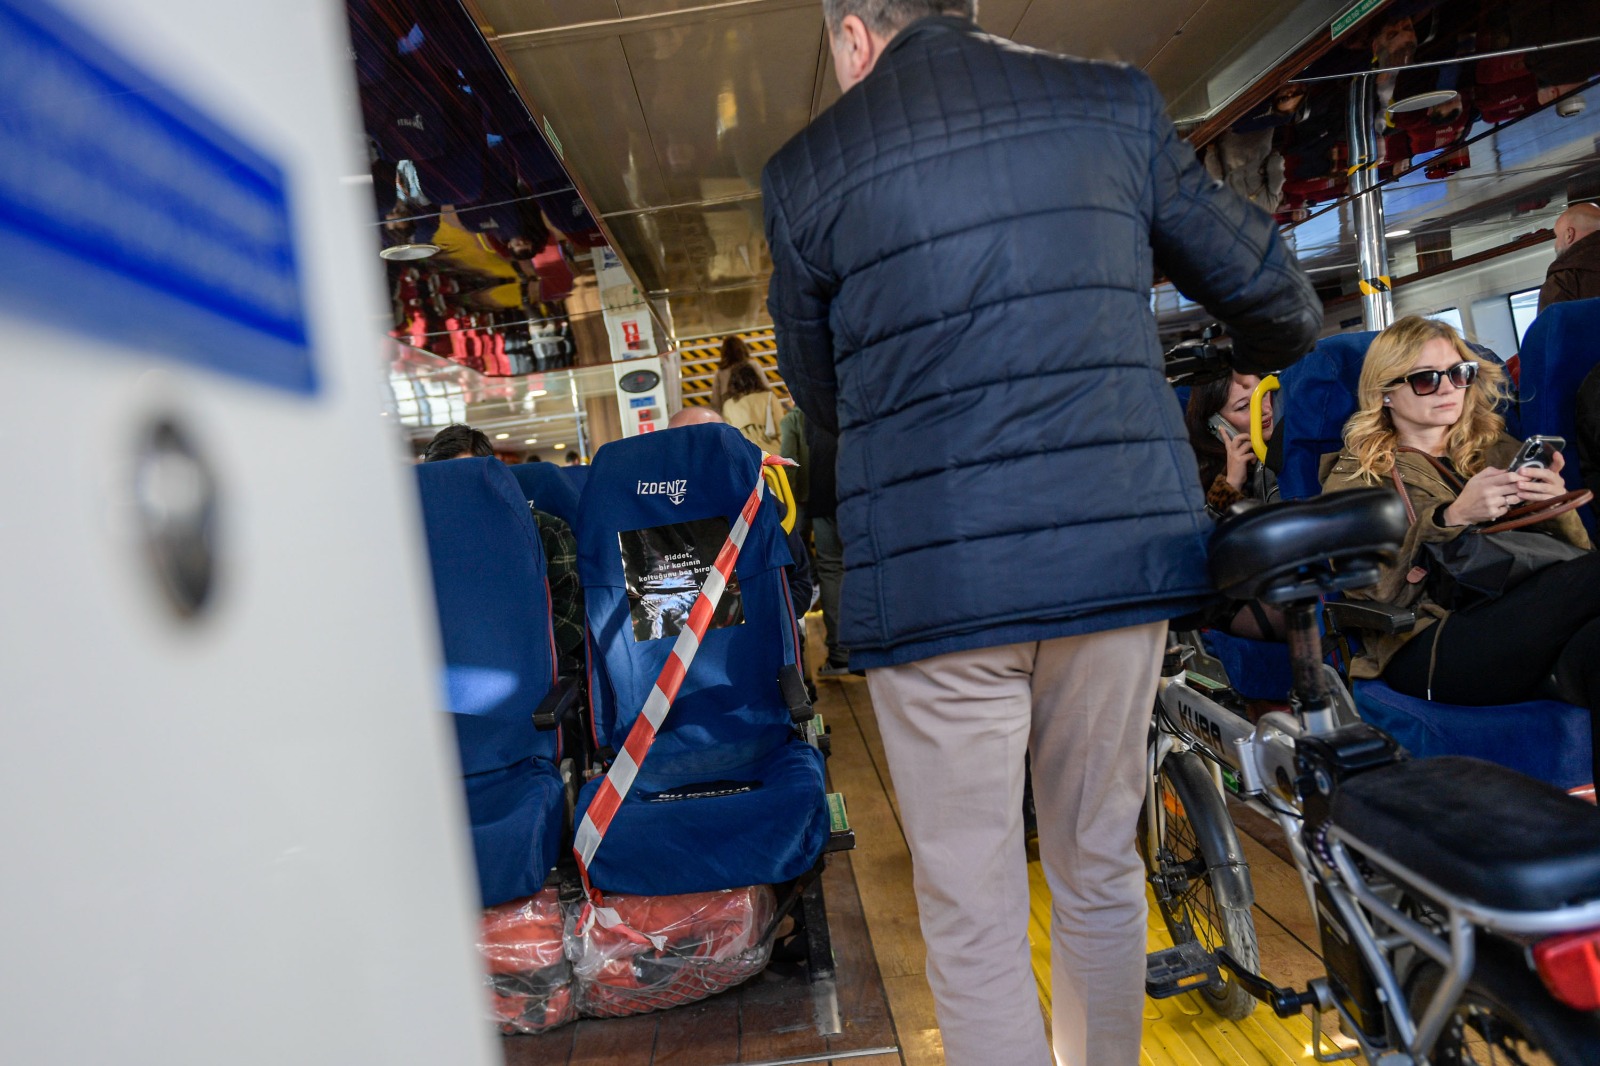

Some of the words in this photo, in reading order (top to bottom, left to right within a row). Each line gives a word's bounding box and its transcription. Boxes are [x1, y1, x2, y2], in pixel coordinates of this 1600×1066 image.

[664, 552, 693, 562] Şiddet,
[671, 559, 701, 569] kadının
[638, 569, 678, 583] koltuğunu
